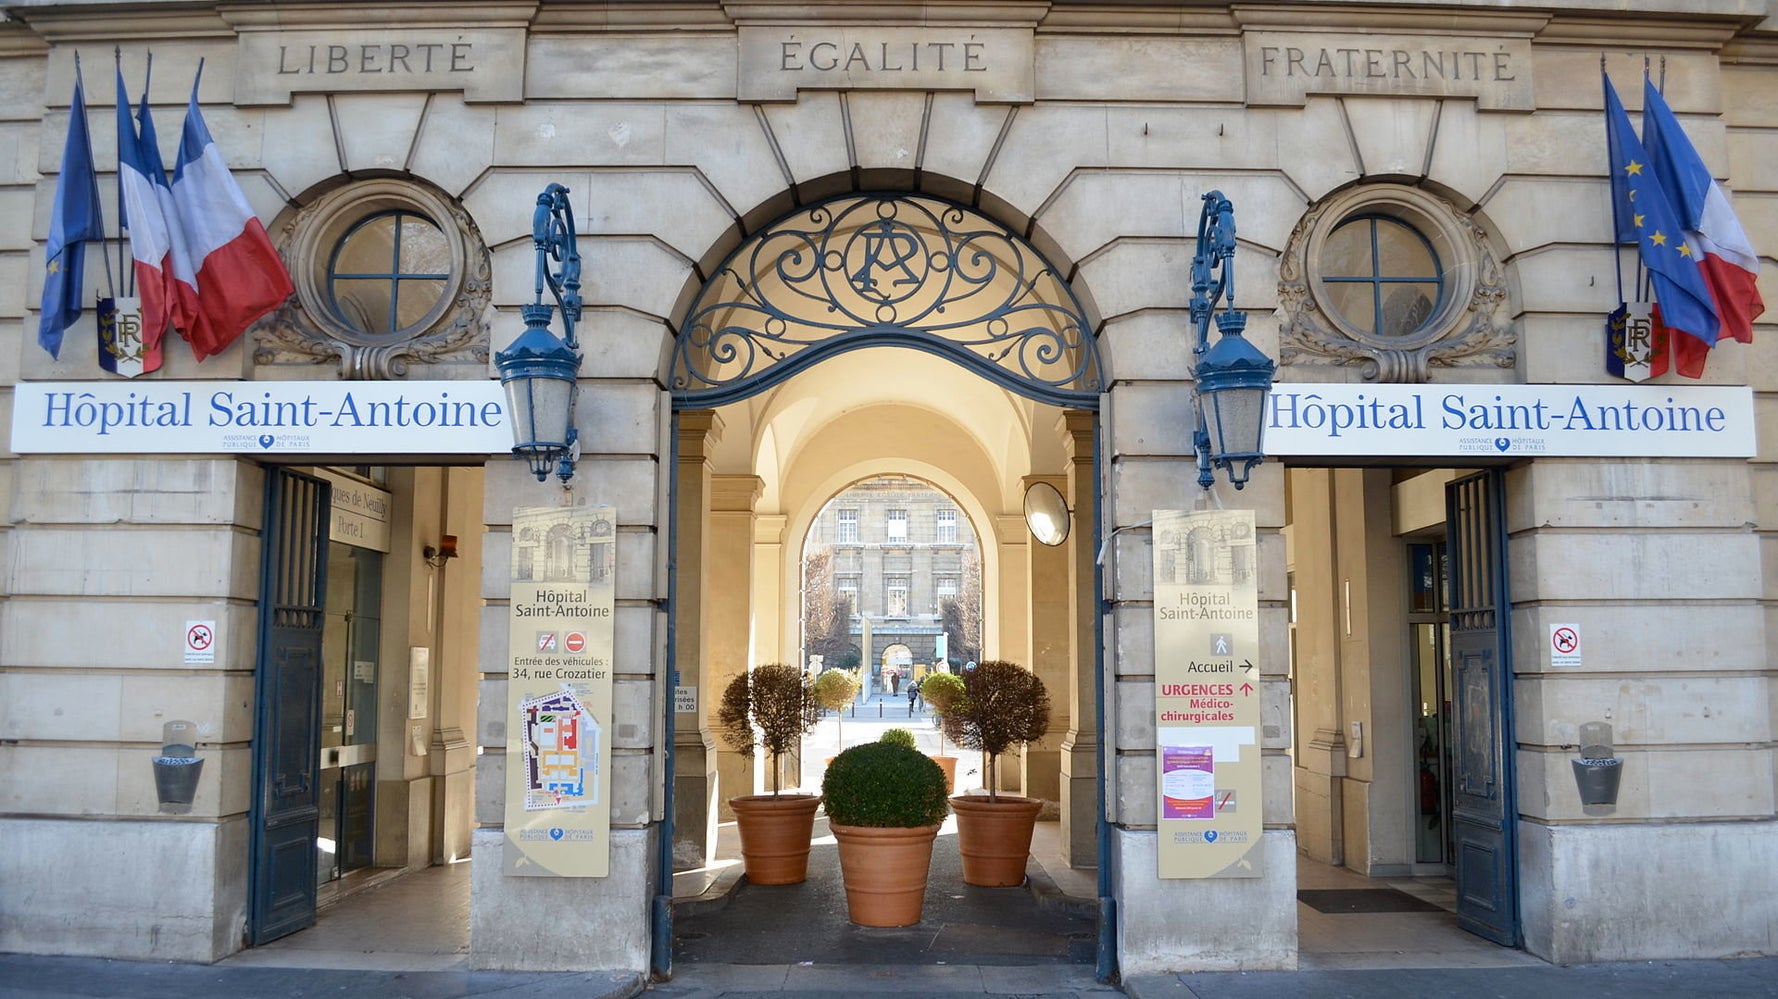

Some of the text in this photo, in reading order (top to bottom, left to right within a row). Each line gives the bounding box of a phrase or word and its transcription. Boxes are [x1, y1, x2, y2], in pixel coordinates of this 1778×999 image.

[277, 35, 474, 74] LIBERTÉ
[780, 34, 987, 71] ÉGALITÉ
[1260, 45, 1516, 81] FRATERNITÉ
[42, 391, 503, 435] Hôpital Saint-Antoine
[1268, 393, 1726, 437] Hôpital Saint-Antoine
[352, 490, 362, 508] de
[363, 492, 388, 518] Neuilly
[336, 515, 359, 537] Porte
[536, 590, 587, 606] Hôpital
[1180, 592, 1230, 608] Hôpital
[515, 604, 609, 617] Saint-Antoine
[1160, 607, 1253, 620] Saint-Antoine
[514, 656, 543, 666] Entrée
[545, 656, 560, 666] des
[562, 656, 604, 666] véhicules
[1187, 661, 1233, 673] Accueil
[512, 668, 607, 680] 34, rue Crozatier
[1161, 684, 1234, 696] URGENCES
[1189, 698, 1234, 709] Médico-
[1160, 711, 1234, 723] chirurgicales
